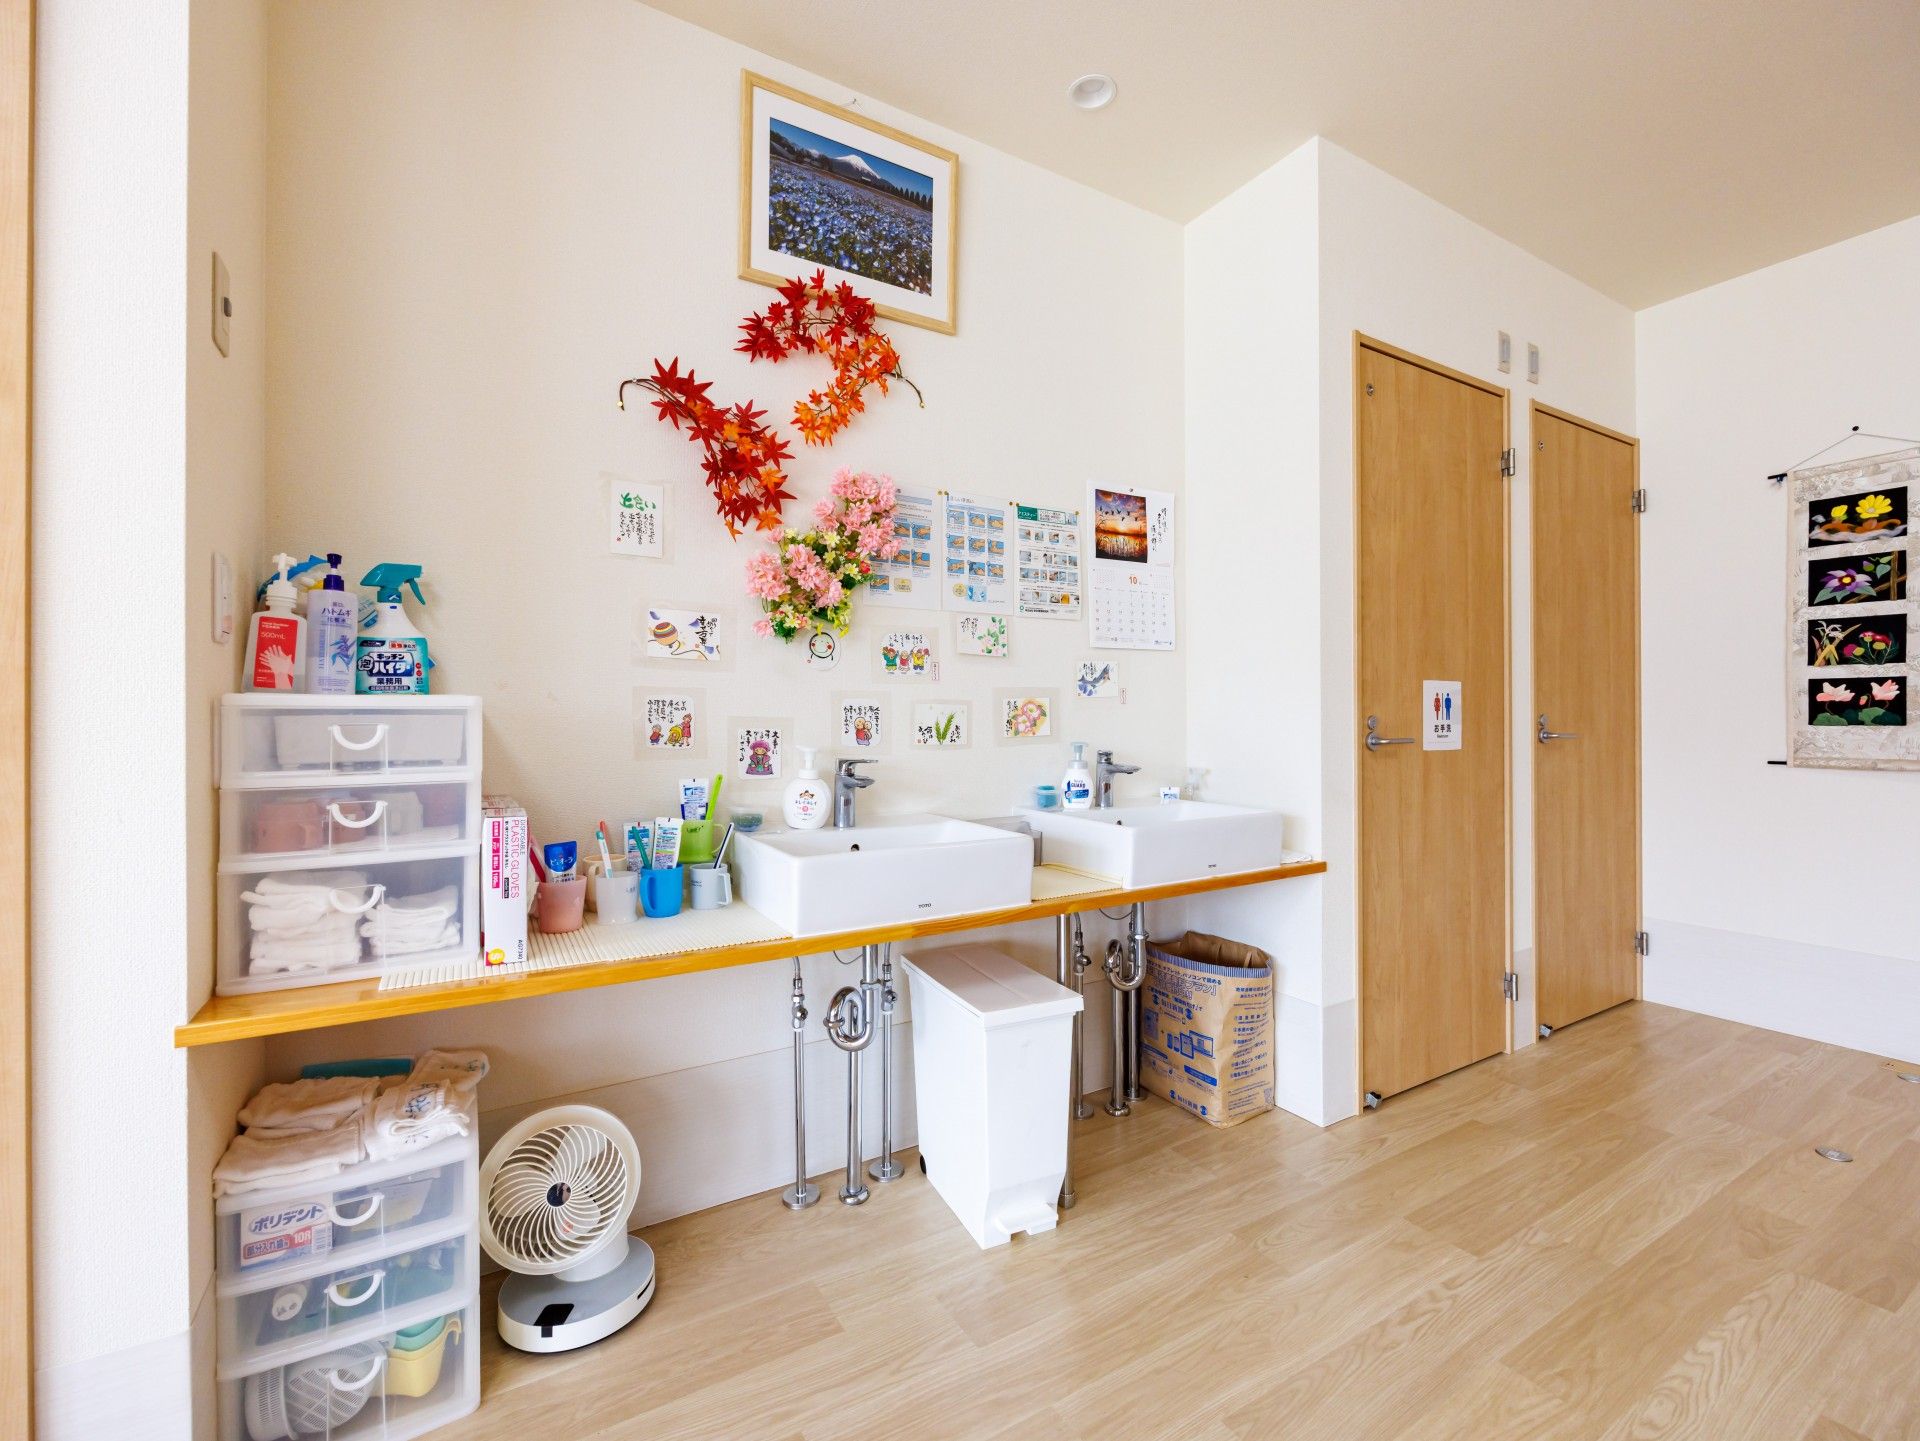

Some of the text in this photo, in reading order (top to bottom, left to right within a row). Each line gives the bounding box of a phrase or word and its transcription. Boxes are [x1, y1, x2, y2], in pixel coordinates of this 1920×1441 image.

[1129, 576, 1138, 585] 10
[321, 607, 352, 617] ハトムギ
[360, 658, 371, 669] 泡
[376, 677, 403, 685] 業務用
[511, 819, 520, 899] PLASTIC GLOVES
[252, 1205, 323, 1233] ポリデント
